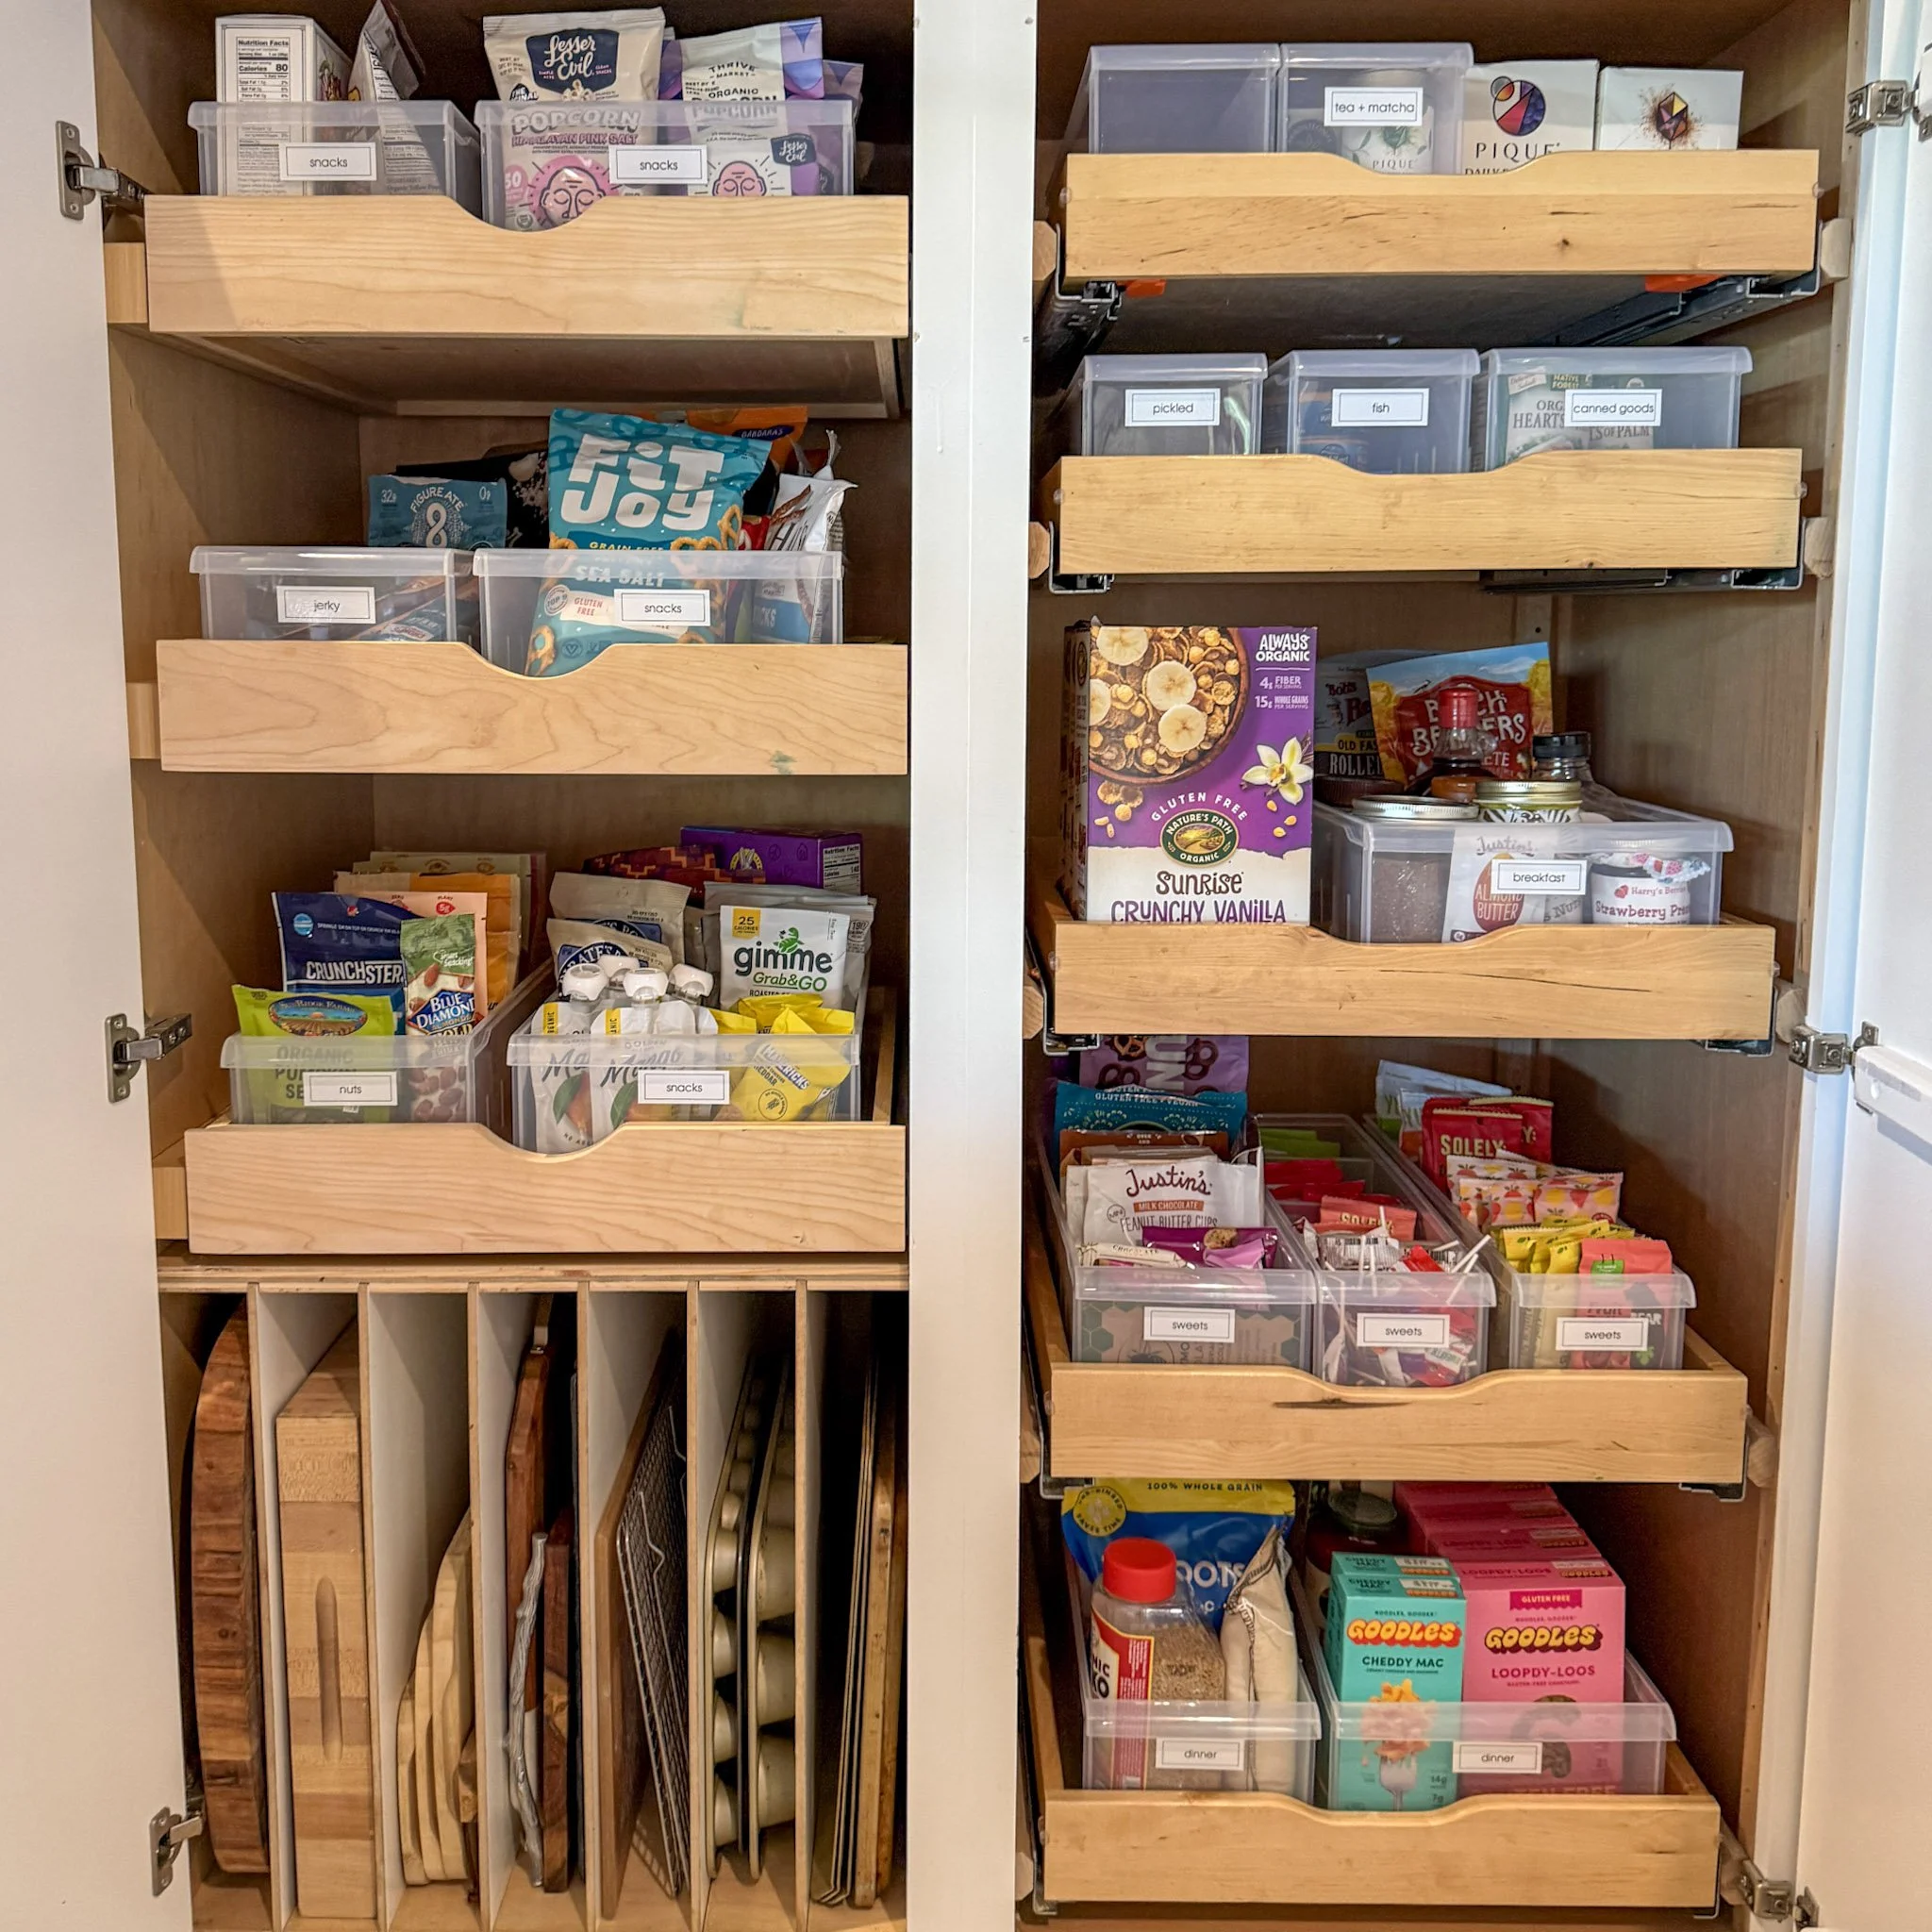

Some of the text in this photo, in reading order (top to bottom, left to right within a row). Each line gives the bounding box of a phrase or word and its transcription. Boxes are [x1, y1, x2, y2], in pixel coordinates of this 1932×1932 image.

[543, 35, 596, 68] Lesser
[275, 63, 289, 72] 80
[557, 51, 595, 80] Evil
[708, 60, 757, 74] THRIVE
[708, 87, 759, 99] ORGANIC
[1335, 102, 1355, 113] tea
[1367, 102, 1415, 113] matcha
[511, 108, 641, 135] POPCORN
[511, 132, 639, 147] HIMALAYAN PINK SALT
[309, 157, 349, 168] snacks
[640, 159, 678, 172] snacks
[1152, 402, 1194, 416] pickled
[1372, 402, 1391, 414] fish
[1573, 403, 1655, 416] canned goods
[1617, 425, 1650, 439] PALM
[409, 487, 465, 513] FIGURE ATE
[575, 565, 665, 588] SEA SALT
[313, 599, 341, 614] jerky
[574, 597, 603, 608] GLUTEN
[644, 604, 682, 614] snacks
[576, 607, 595, 617] FREE
[1258, 632, 1311, 651] ALWAYS
[1256, 650, 1310, 662] ORGANIC
[1274, 675, 1302, 685] FIBER
[1338, 740, 1357, 751] OLD
[1151, 791, 1248, 822] GLUTEN FREE
[1166, 812, 1234, 836] NATURE'S PATH
[1179, 852, 1221, 863] ORGANIC
[1156, 870, 1242, 896] Sunrise
[1512, 872, 1566, 883] breakfast
[1631, 887, 1662, 897] Harry's
[1110, 899, 1287, 924] CRUNCHY VANILLA
[1477, 903, 1519, 921] BUTTER
[1595, 900, 1666, 921] Strawberry
[739, 916, 755, 925] 25
[733, 941, 833, 976] gimme
[306, 960, 405, 985] CRUNCHSTER
[753, 972, 827, 992] Grab&GO
[429, 992, 464, 1013] BLUE
[276, 1044, 355, 1064] ORGANIC
[339, 1085, 363, 1095] nuts
[665, 1081, 704, 1093] snacks
[1094, 1091, 1134, 1103] GLUTEN
[1125, 1165, 1211, 1198] Justin's
[1139, 1200, 1199, 1210] MILK CHOCOLATE
[1120, 1214, 1218, 1233] PEANUT BUTTER CUPS
[1172, 1321, 1208, 1332] sweets
[1385, 1326, 1423, 1337] sweets
[1584, 1331, 1622, 1341] sweets
[1147, 1482, 1263, 1492] 100% WHOLE GRAIN
[1102, 1516, 1123, 1534] TIME
[1347, 1619, 1461, 1648] GOODLES
[1484, 1624, 1603, 1655] GOODLES
[1361, 1656, 1444, 1669] CHEDDY MAC
[1491, 1665, 1596, 1679] LOOPDY-LOOS
[1184, 1749, 1218, 1759] dinner
[1481, 1753, 1515, 1763] dinner
